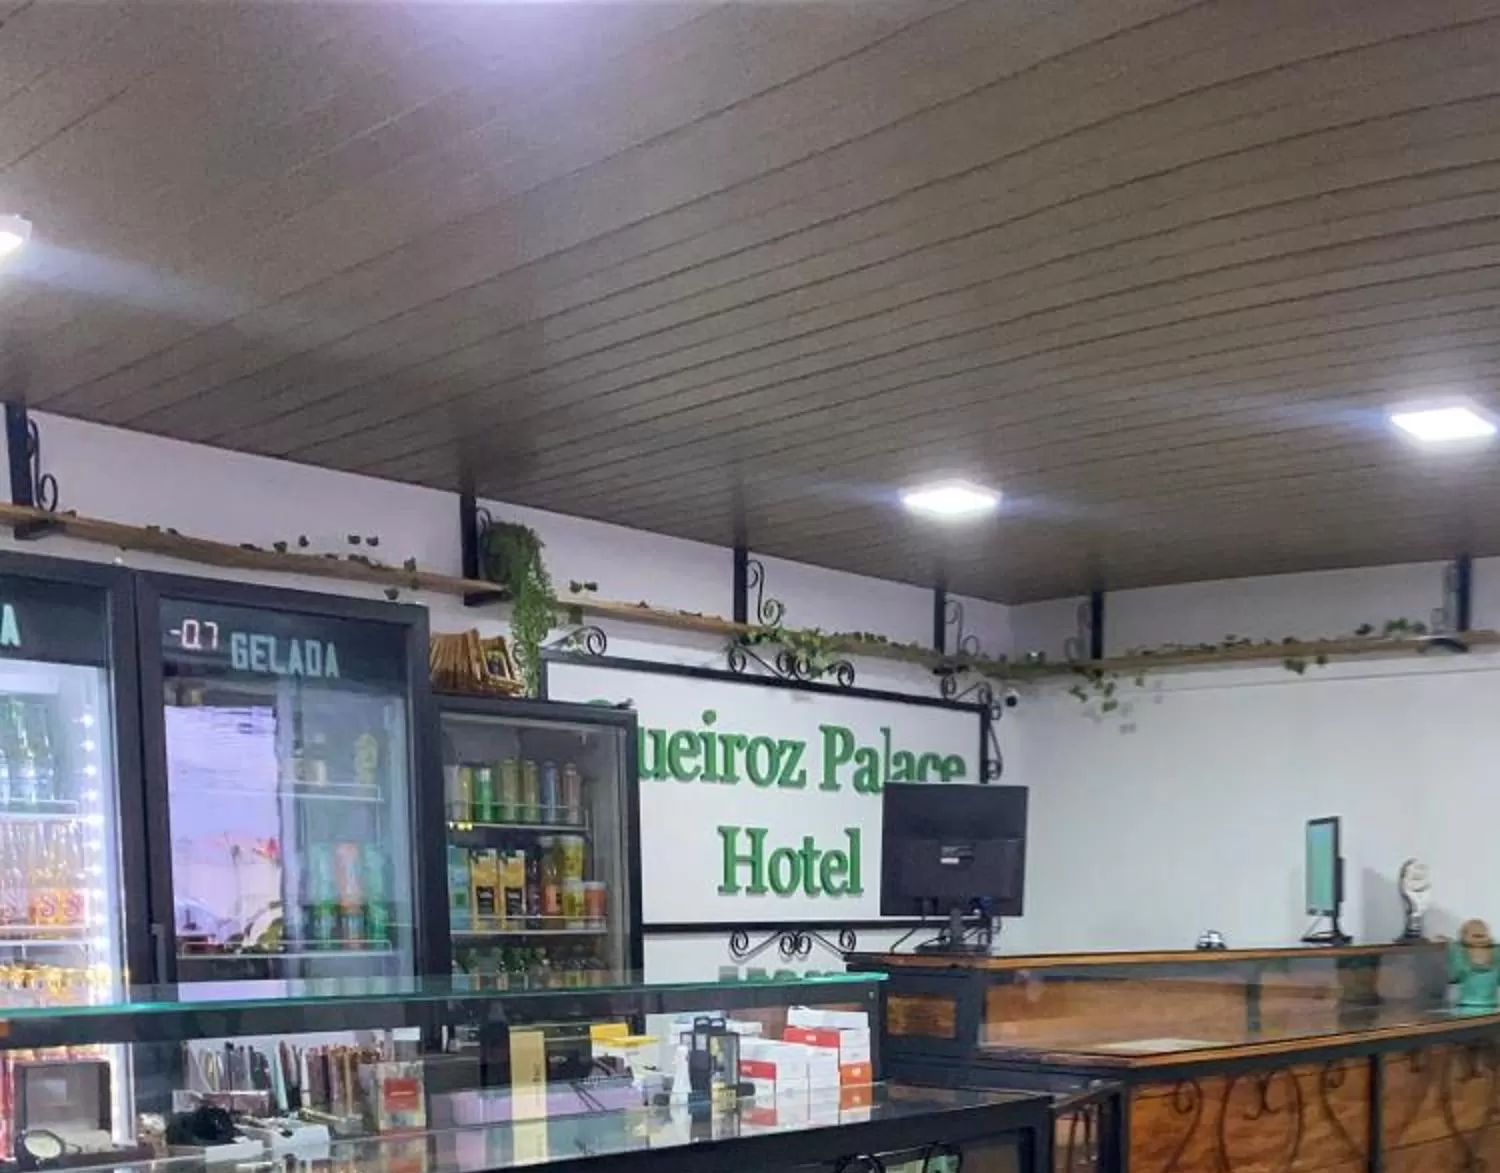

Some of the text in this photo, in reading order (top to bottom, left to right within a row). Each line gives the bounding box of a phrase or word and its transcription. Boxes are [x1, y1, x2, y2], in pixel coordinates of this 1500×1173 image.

[231, 631, 340, 678] GELADA
[637, 709, 807, 789] ueiroz
[717, 824, 864, 897] Hotel
